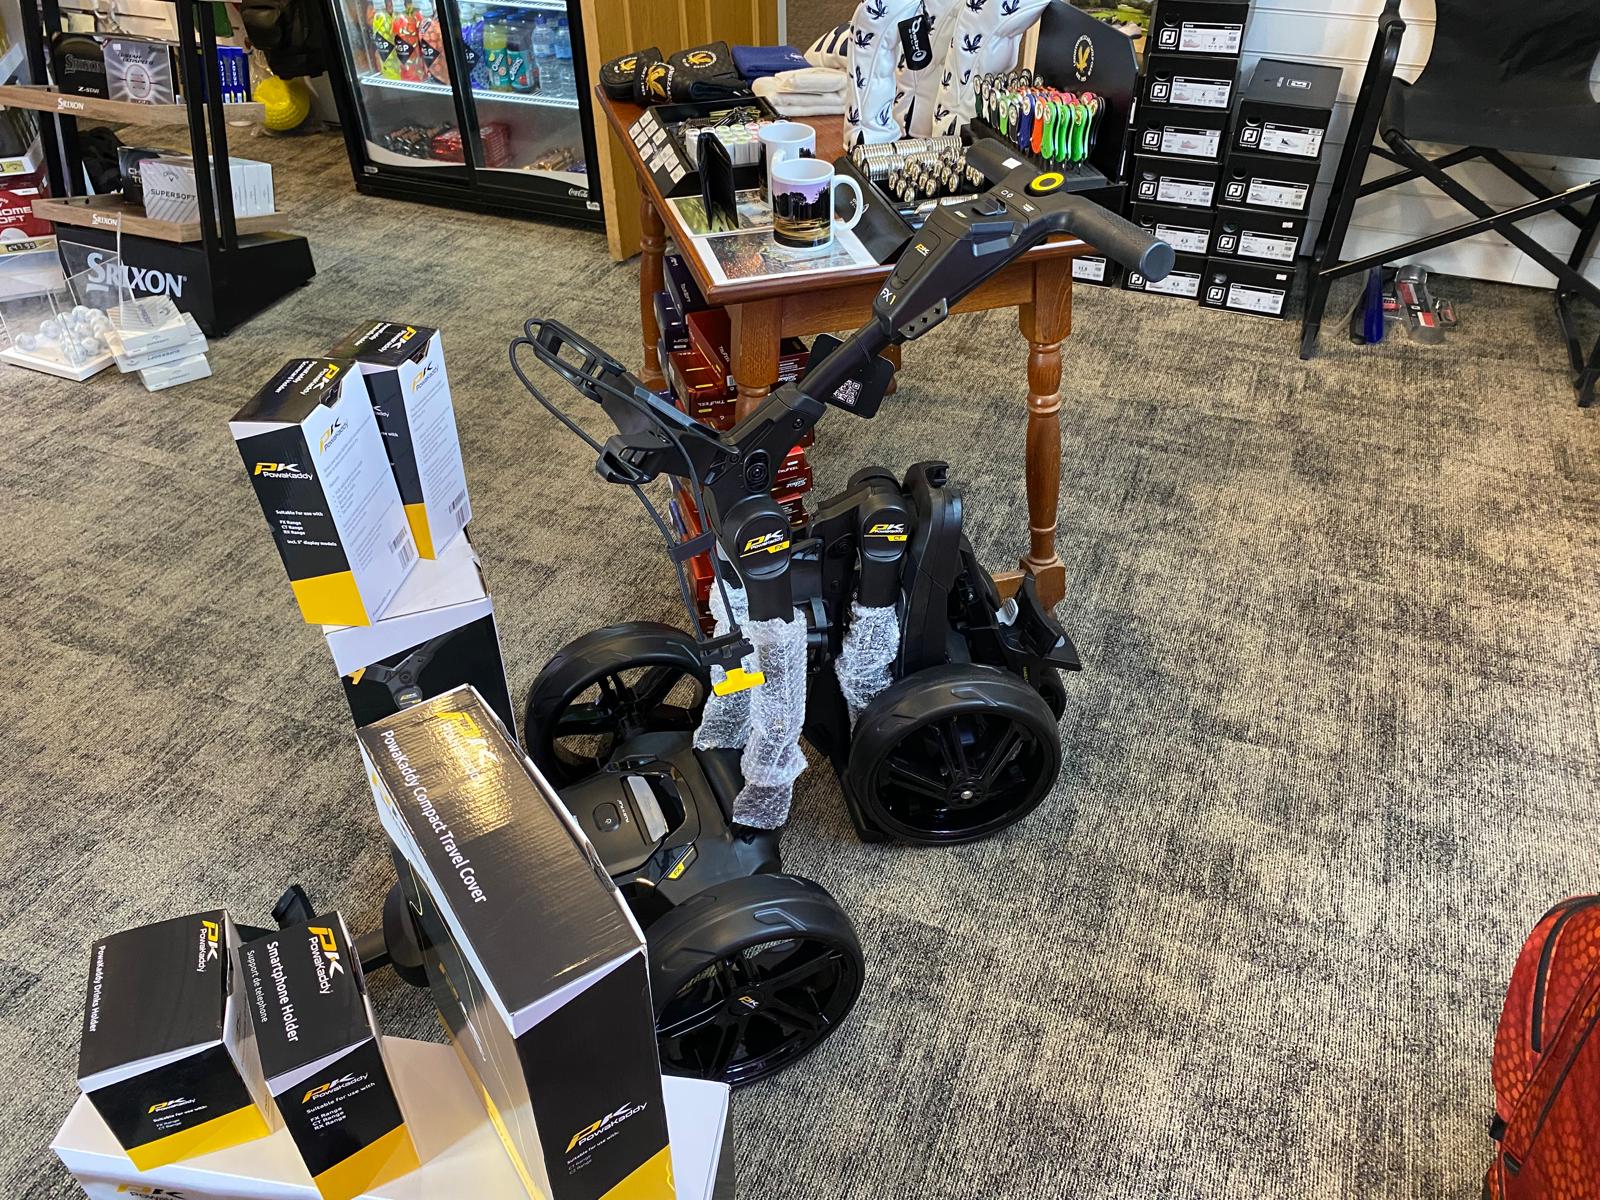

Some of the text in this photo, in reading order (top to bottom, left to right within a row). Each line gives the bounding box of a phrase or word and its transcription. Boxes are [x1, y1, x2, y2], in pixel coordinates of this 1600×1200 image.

[1161, 30, 1177, 44] FJ
[1153, 84, 1167, 97] FJ
[57, 97, 84, 110] SRIXON
[1145, 133, 1159, 145] FJ
[1243, 129, 1258, 142] FJ
[150, 188, 197, 201] SUPERSOFT
[1141, 183, 1154, 195] FJ
[1228, 184, 1243, 197] FJ
[91, 213, 118, 226] SRIXON
[1220, 236, 1234, 249] FJ
[85, 252, 184, 298] SRIXON
[1131, 273, 1143, 284] FJ
[1209, 288, 1223, 300] FJ
[390, 326, 417, 350] PK
[312, 362, 340, 390] PK
[319, 416, 341, 456] PK
[253, 462, 301, 477] PK
[262, 471, 314, 481] PowaKaddy
[869, 523, 904, 534] PK
[744, 529, 784, 551] PK
[750, 536, 784, 550] PowaKaddy
[380, 729, 487, 903] PowaKaddy Compact Travel Cover
[200, 919, 219, 962] PK
[196, 928, 207, 972] PowaKaddy
[307, 926, 345, 979] PK
[308, 936, 332, 994] PowaKaddy
[89, 945, 106, 1032] PowaKaddy Drinks Holder
[246, 949, 268, 1023] Support de telephone
[266, 941, 299, 1042] Smartphone Holder
[302, 1072, 355, 1104] PK
[312, 1072, 369, 1101] PowaKaddy
[148, 1097, 185, 1114] PK
[155, 1098, 196, 1112] PowaKaddy
[306, 1081, 376, 1114] Suitable for use with
[153, 1114, 175, 1122] Suitable
[312, 1111, 344, 1127] CT Range
[320, 1106, 342, 1118] Range
[314, 1115, 346, 1131] RX Range
[565, 1101, 632, 1154] PK
[578, 1102, 648, 1146] PowaKaddy
